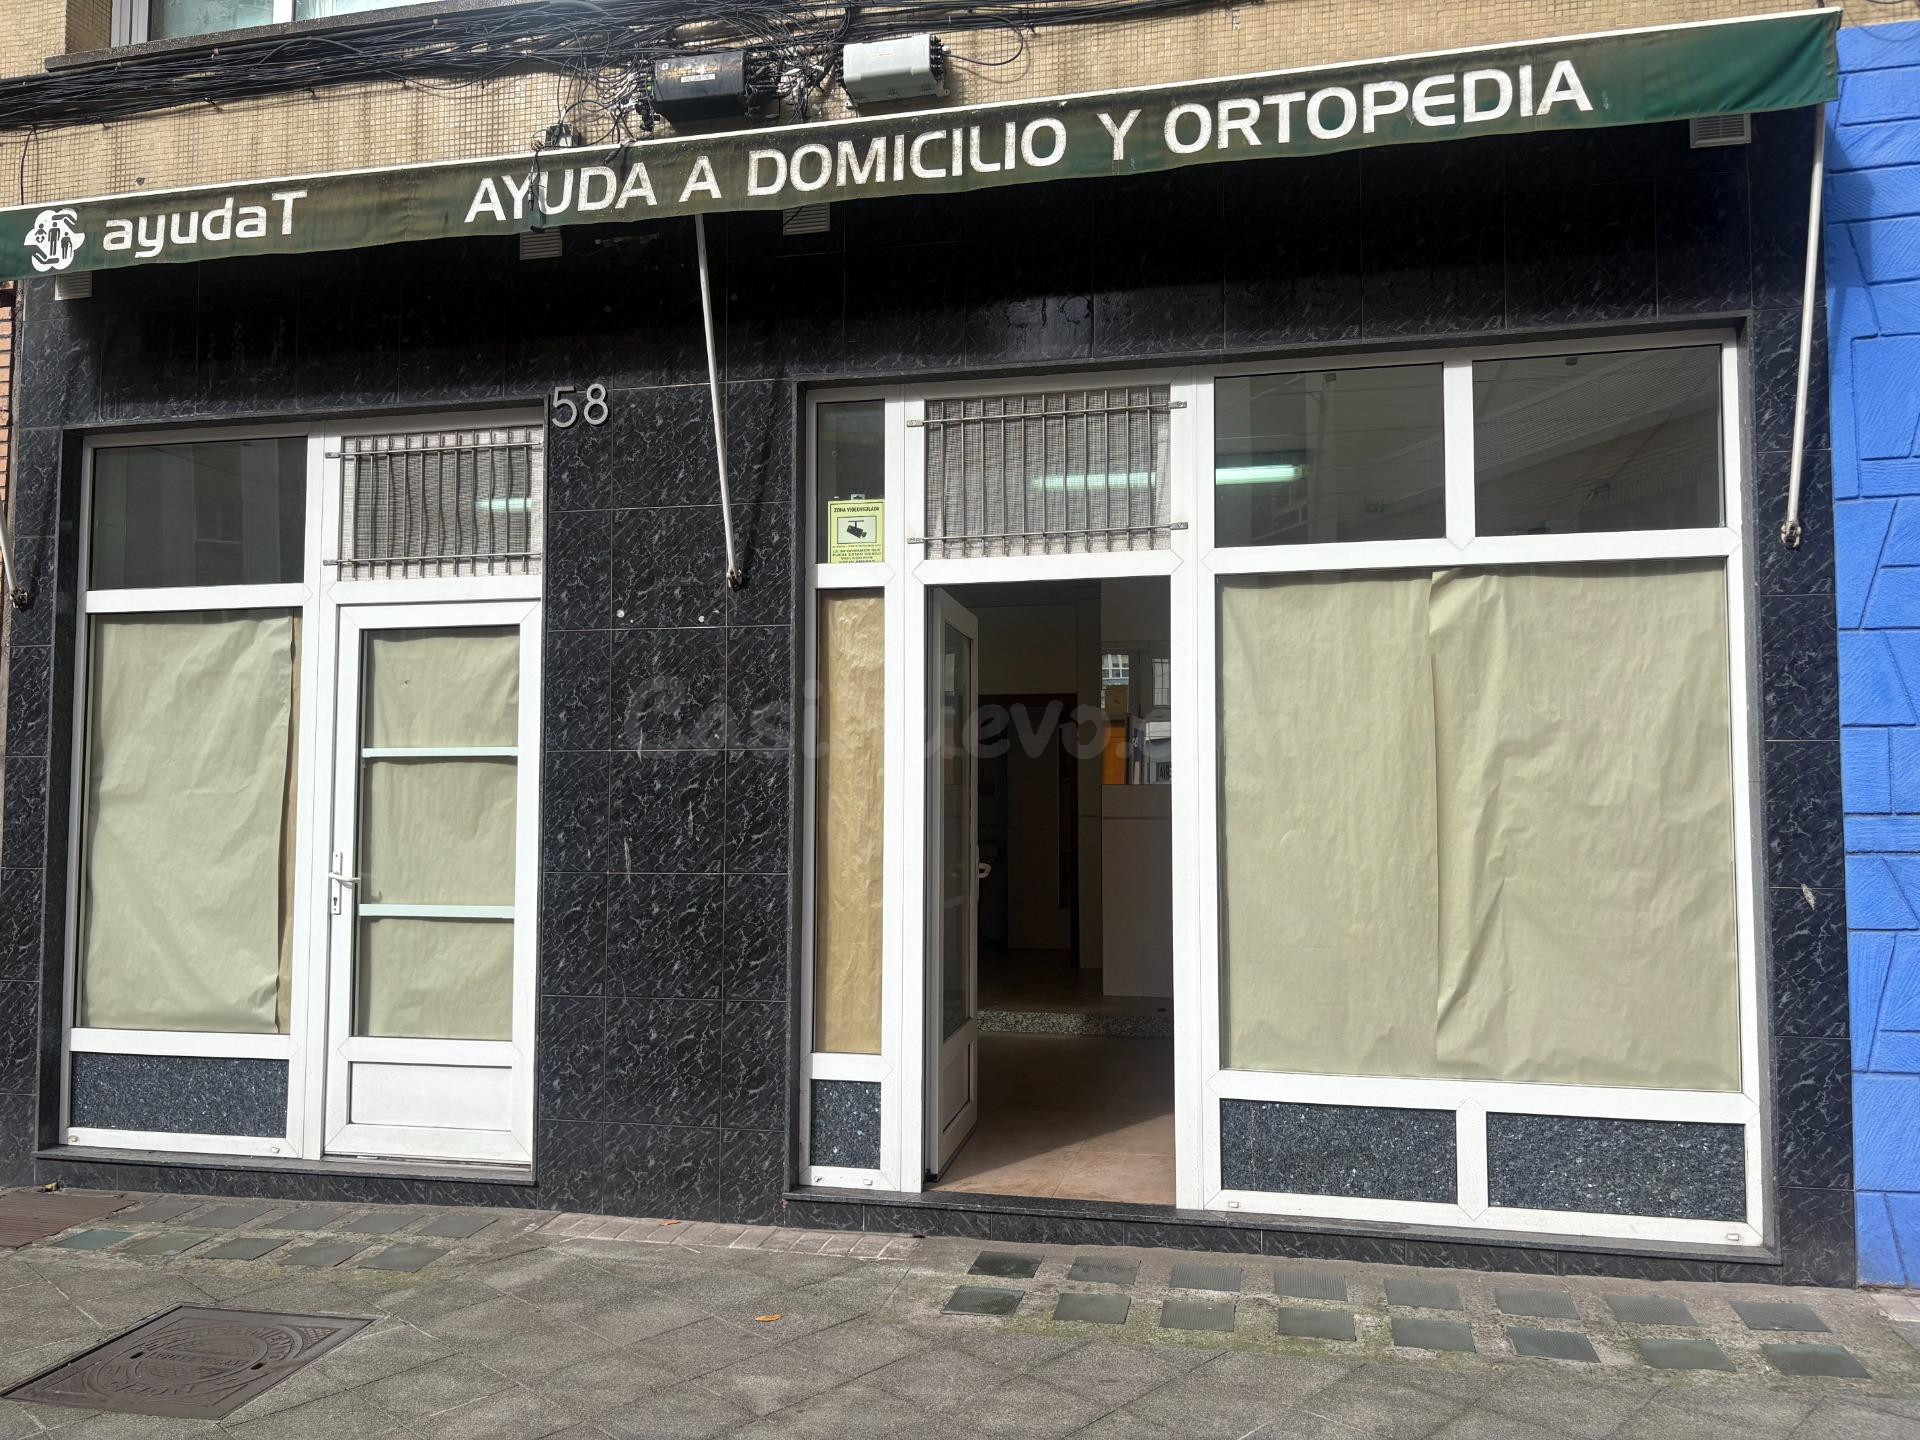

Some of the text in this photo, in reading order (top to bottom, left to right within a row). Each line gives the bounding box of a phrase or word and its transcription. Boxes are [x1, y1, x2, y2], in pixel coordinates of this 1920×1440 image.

[463, 60, 1594, 225] AYUDA A DOMICILIO Y ORTOPEDIA
[102, 189, 308, 259] ayudaT
[551, 383, 609, 429] 58
